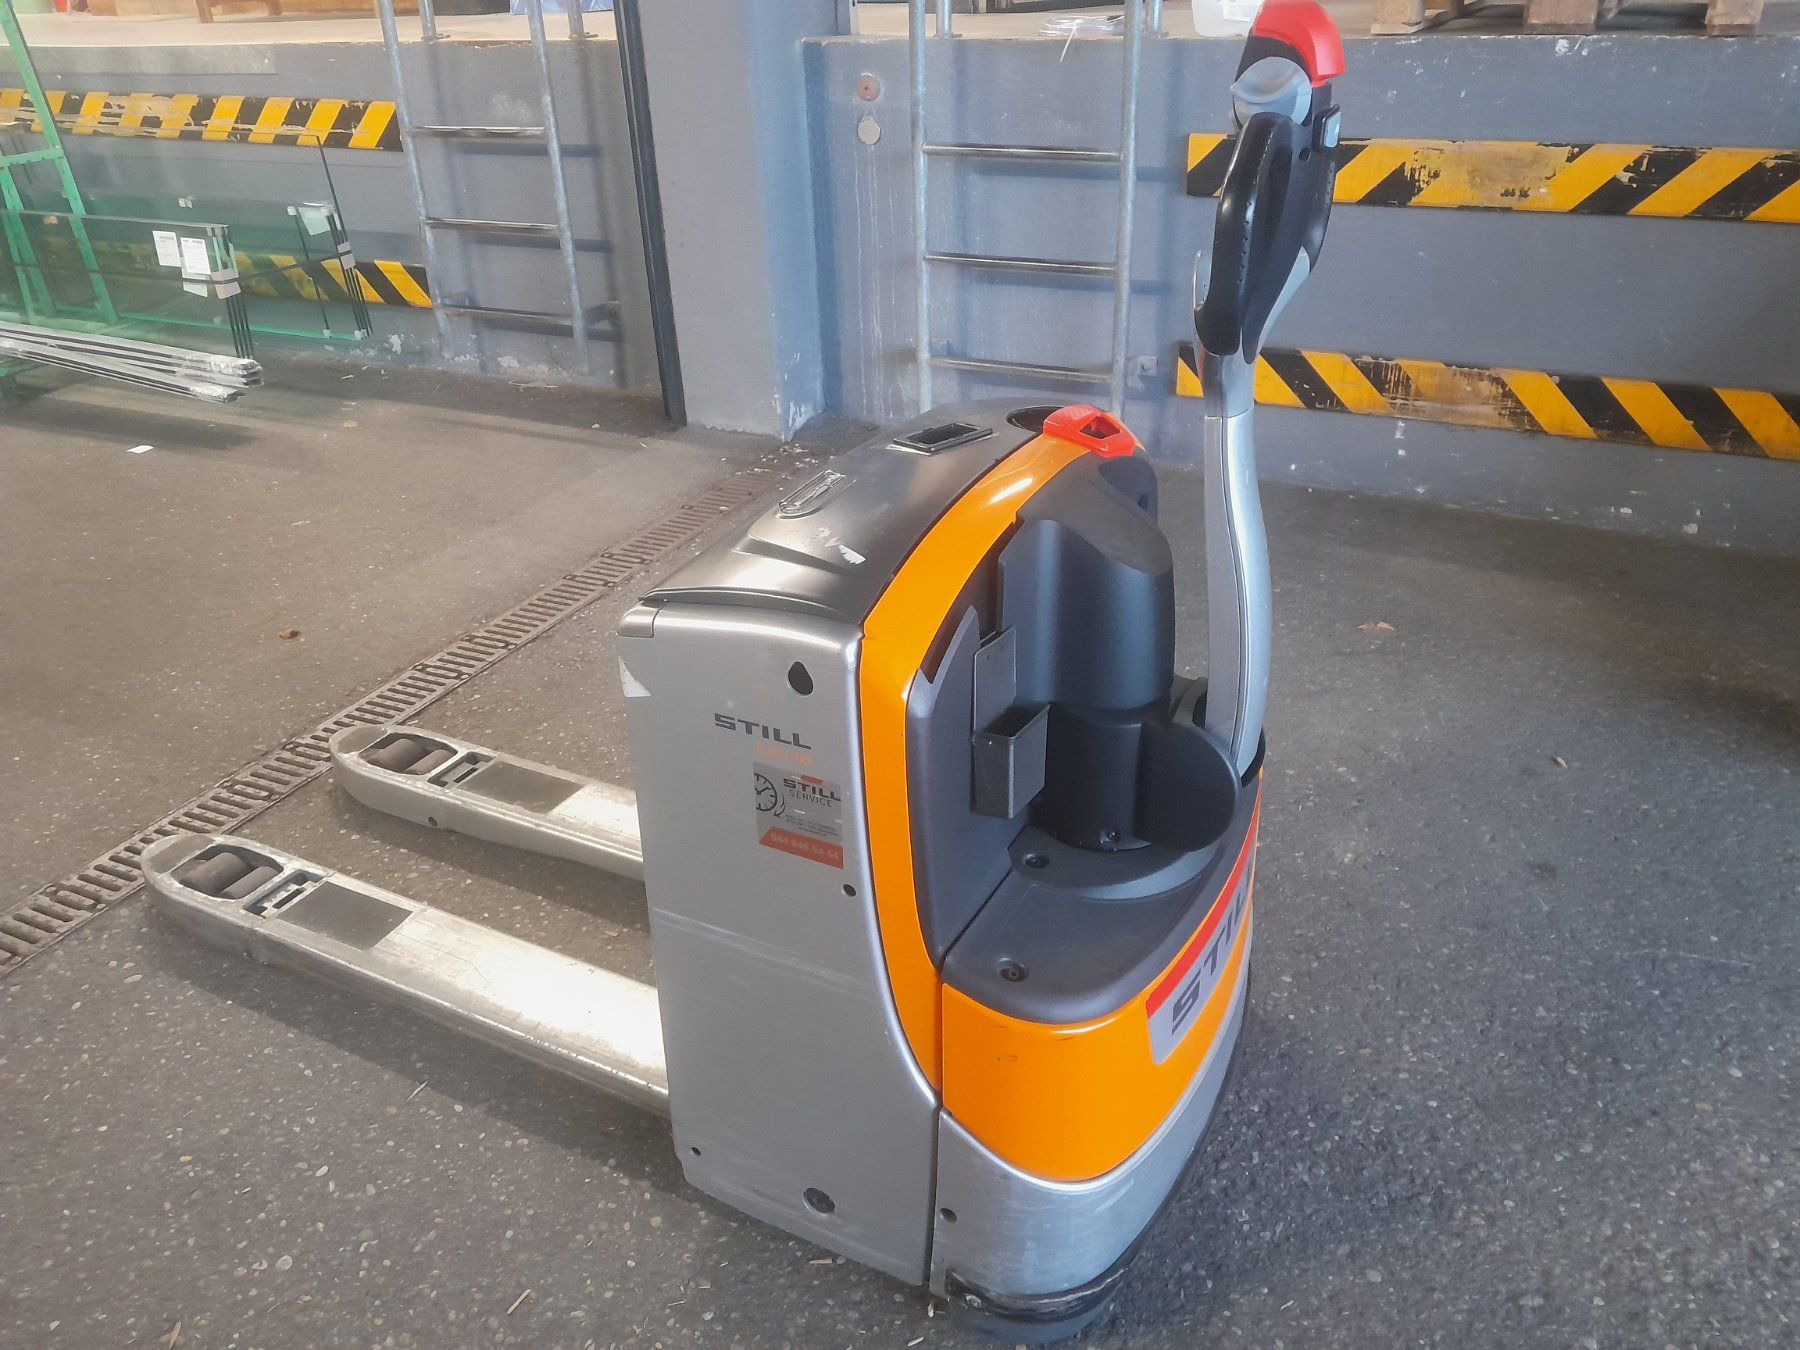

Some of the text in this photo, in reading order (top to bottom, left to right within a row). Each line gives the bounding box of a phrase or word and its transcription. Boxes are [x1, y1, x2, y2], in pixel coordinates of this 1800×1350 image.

[714, 713, 811, 750] STILL
[783, 778, 841, 802] STILL
[789, 789, 832, 808] SERVICE
